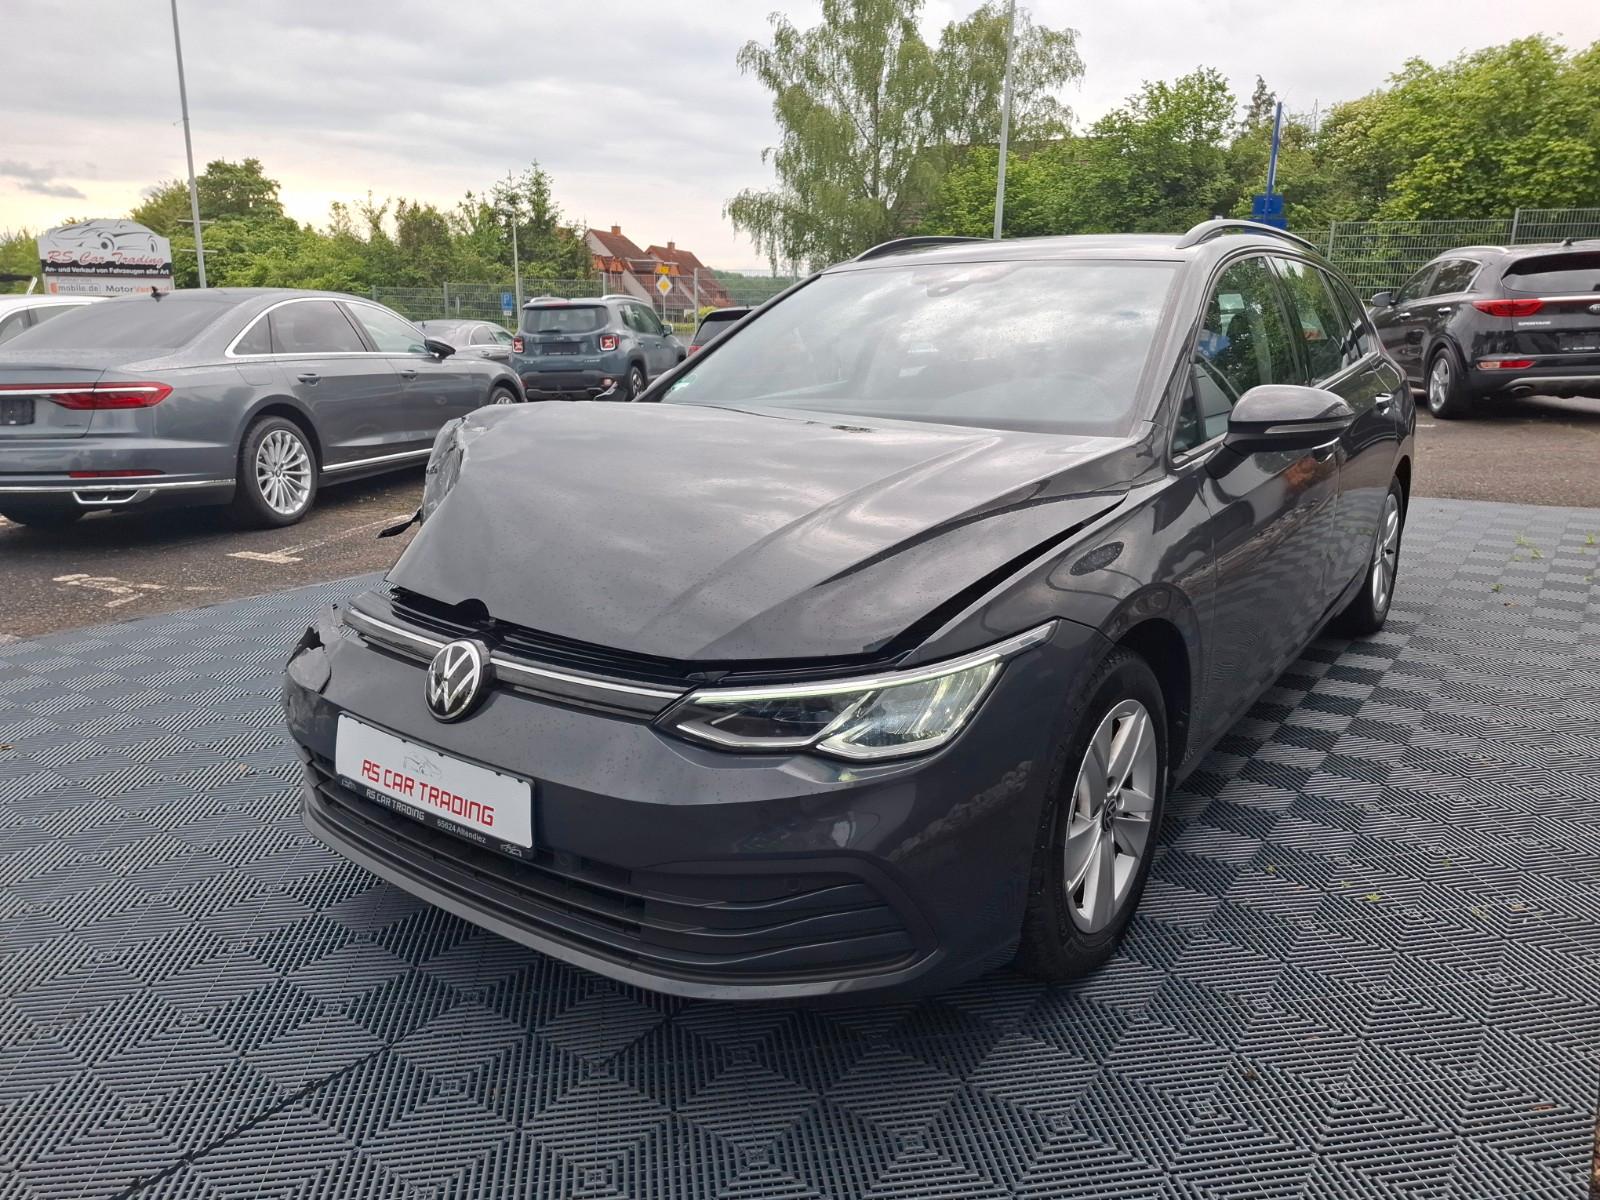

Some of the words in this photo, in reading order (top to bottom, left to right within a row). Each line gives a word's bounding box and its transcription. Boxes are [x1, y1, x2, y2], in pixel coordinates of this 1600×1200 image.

[47, 250, 73, 263] RS
[79, 250, 106, 264] Car
[111, 251, 164, 268] Trading
[109, 267, 145, 275] Fahrzeugen
[362, 759, 380, 783] RS
[383, 768, 415, 797] CAR
[419, 781, 495, 827] TRADING
[366, 788, 376, 800] RS
[376, 793, 391, 806] CAR
[392, 799, 425, 820] TRADING
